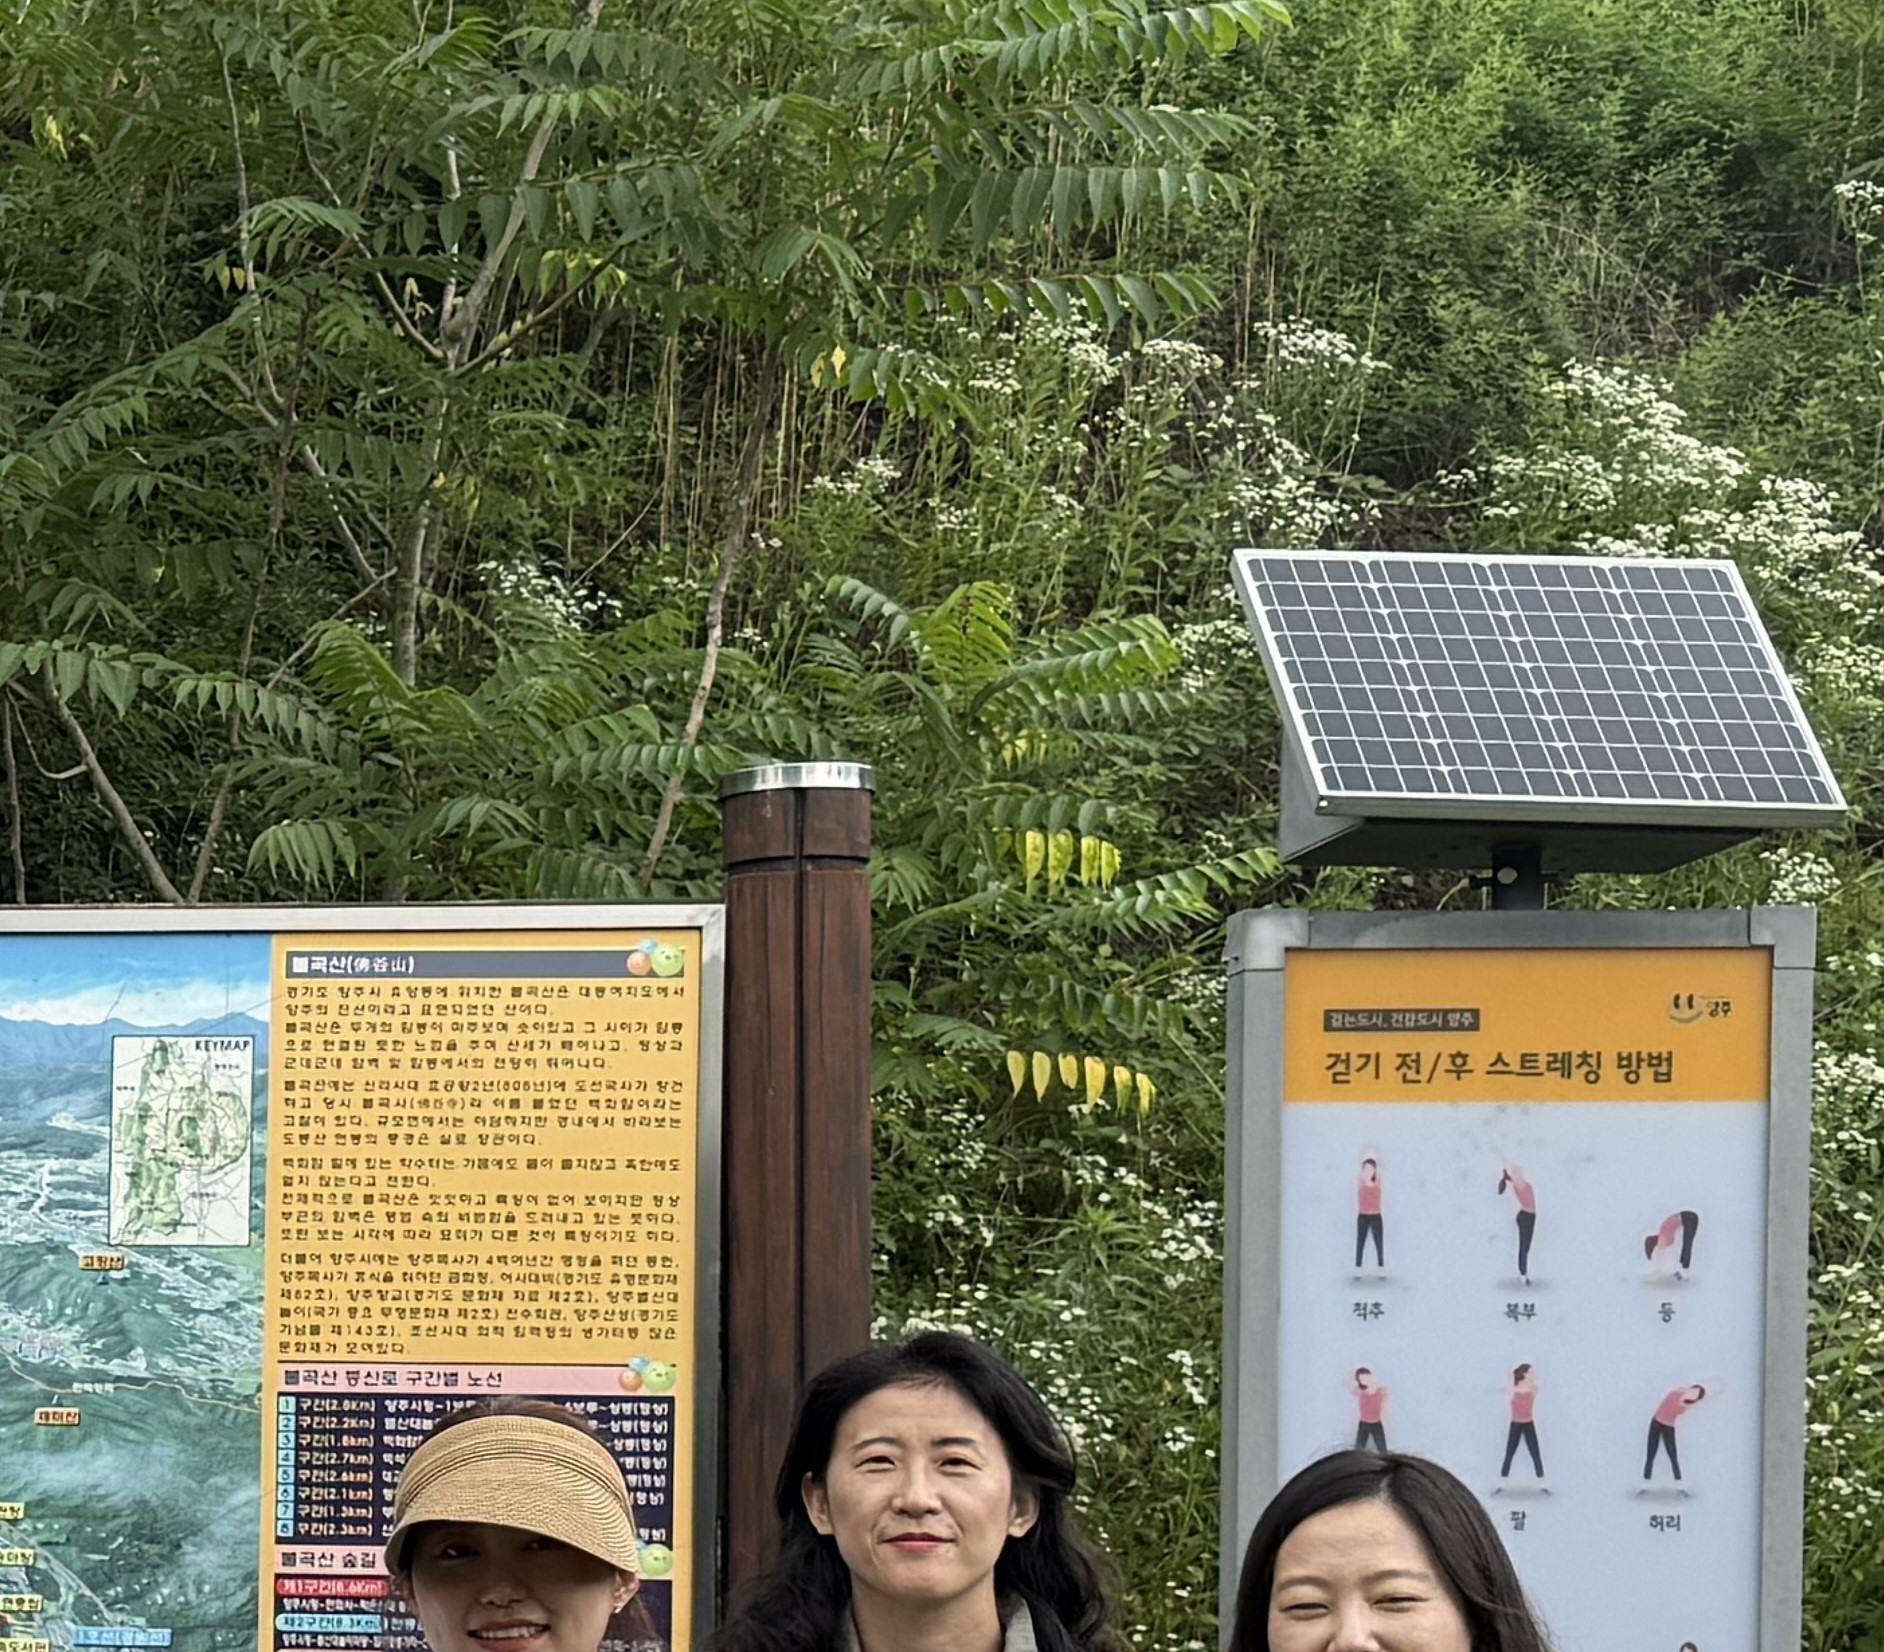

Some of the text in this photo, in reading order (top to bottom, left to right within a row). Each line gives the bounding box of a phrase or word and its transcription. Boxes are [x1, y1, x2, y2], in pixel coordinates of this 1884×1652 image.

[337, 985, 381, 999] 양주시
[583, 1020, 596, 1034] 그
[1447, 1012, 1476, 1028] 양주
[194, 1040, 250, 1052] KEYMAP
[1325, 1049, 1675, 1086] 걷기 전/후 스트레칭 방법
[1352, 1301, 1385, 1321] 척추
[1504, 1302, 1538, 1322] 복부
[1658, 1303, 1676, 1322] 등
[283, 1368, 337, 1386] 불곡산
[405, 1370, 459, 1387] 구간별
[466, 1370, 502, 1388] 노선
[282, 1418, 292, 1428] 2
[1510, 1511, 1527, 1531] 팔
[1648, 1512, 1682, 1532] 허리
